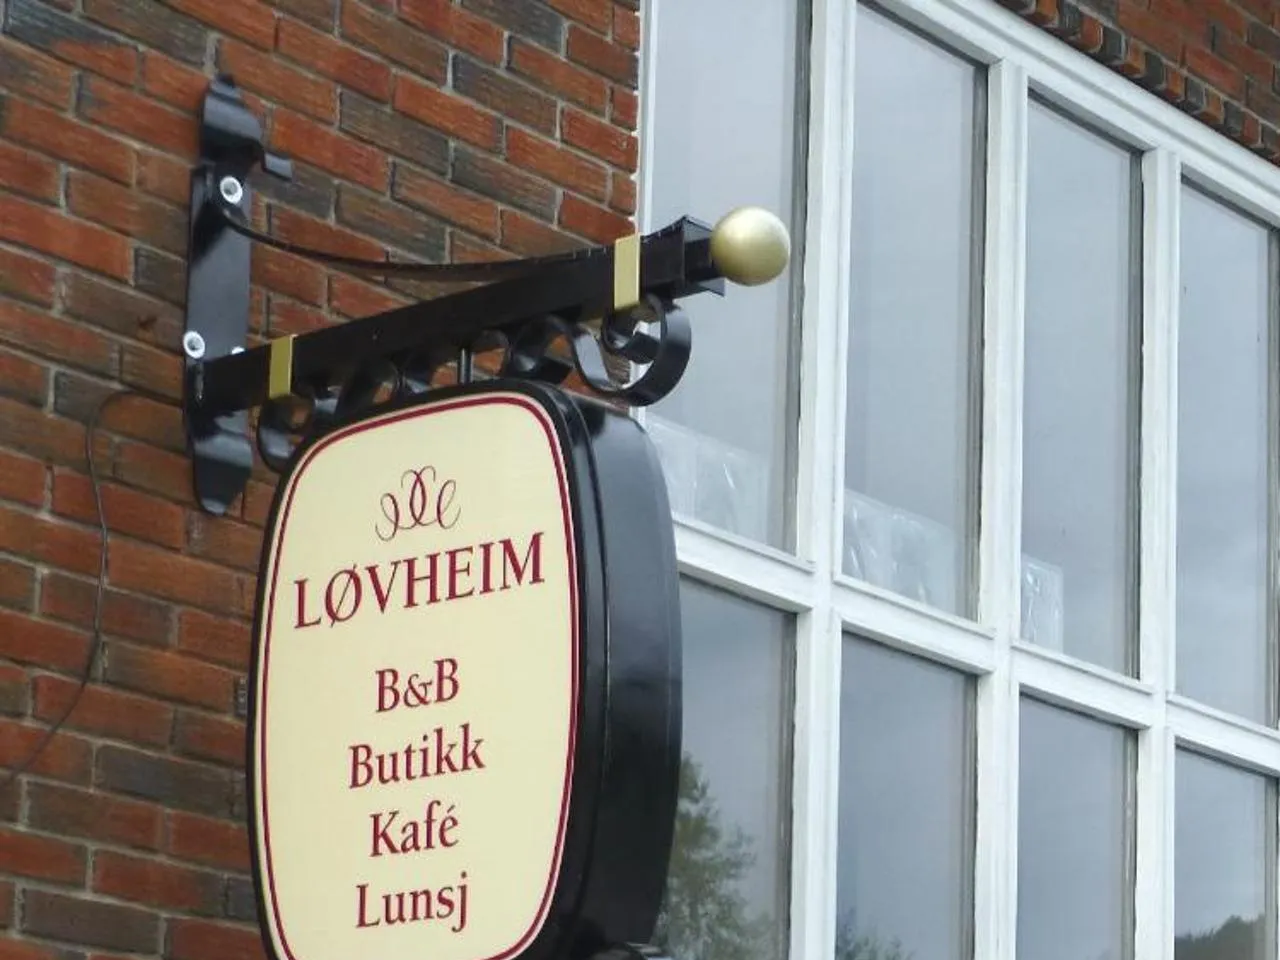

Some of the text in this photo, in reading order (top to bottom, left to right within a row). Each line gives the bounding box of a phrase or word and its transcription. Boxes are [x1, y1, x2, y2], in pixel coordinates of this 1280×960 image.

[294, 531, 546, 629] LØVHEIM
[375, 658, 461, 713] B&B
[349, 722, 486, 790] Butikk
[369, 799, 460, 858] Kafé
[355, 871, 469, 933] Lunsj
